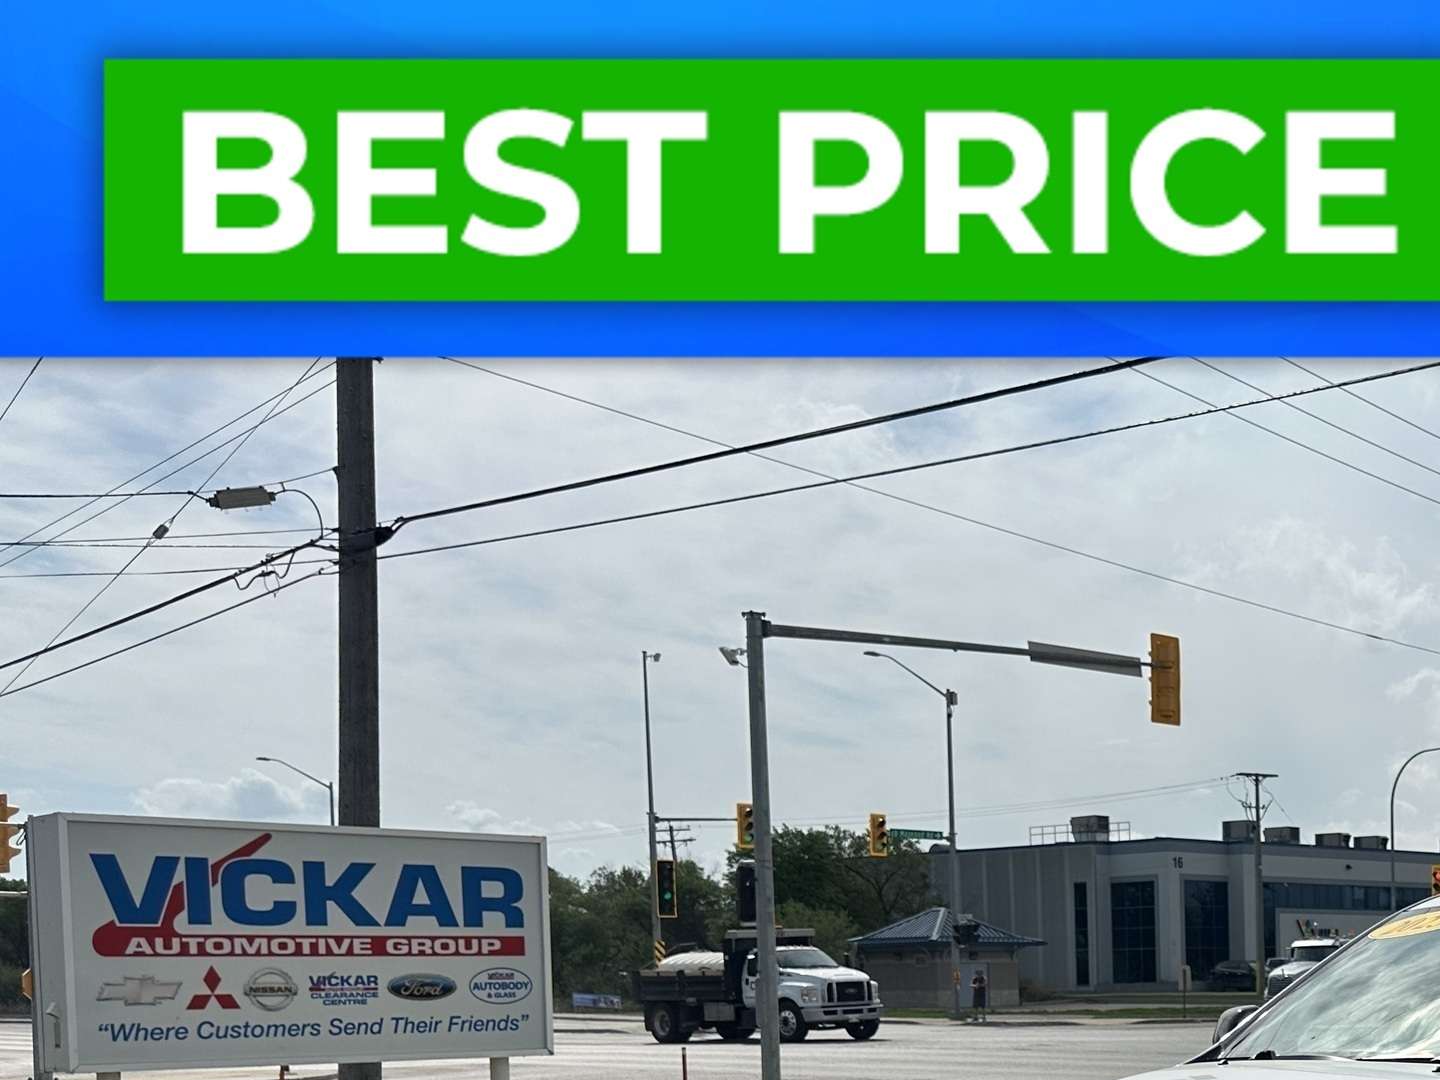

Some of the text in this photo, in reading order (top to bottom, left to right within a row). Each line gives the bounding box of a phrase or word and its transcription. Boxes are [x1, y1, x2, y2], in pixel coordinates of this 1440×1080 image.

[1171, 856, 1184, 869] 16
[88, 852, 525, 929] VICKAR
[125, 936, 502, 956] AUTOMOTIVE GROUP
[308, 974, 379, 987] VICKAR
[472, 981, 530, 991] AUTOBODY
[249, 986, 293, 994] NISSAN
[401, 980, 444, 996] Ford
[310, 991, 379, 1000] CLEARANCE
[494, 991, 517, 999] GLASS
[97, 1014, 530, 1042] “Where Customers Send Their Friends”
